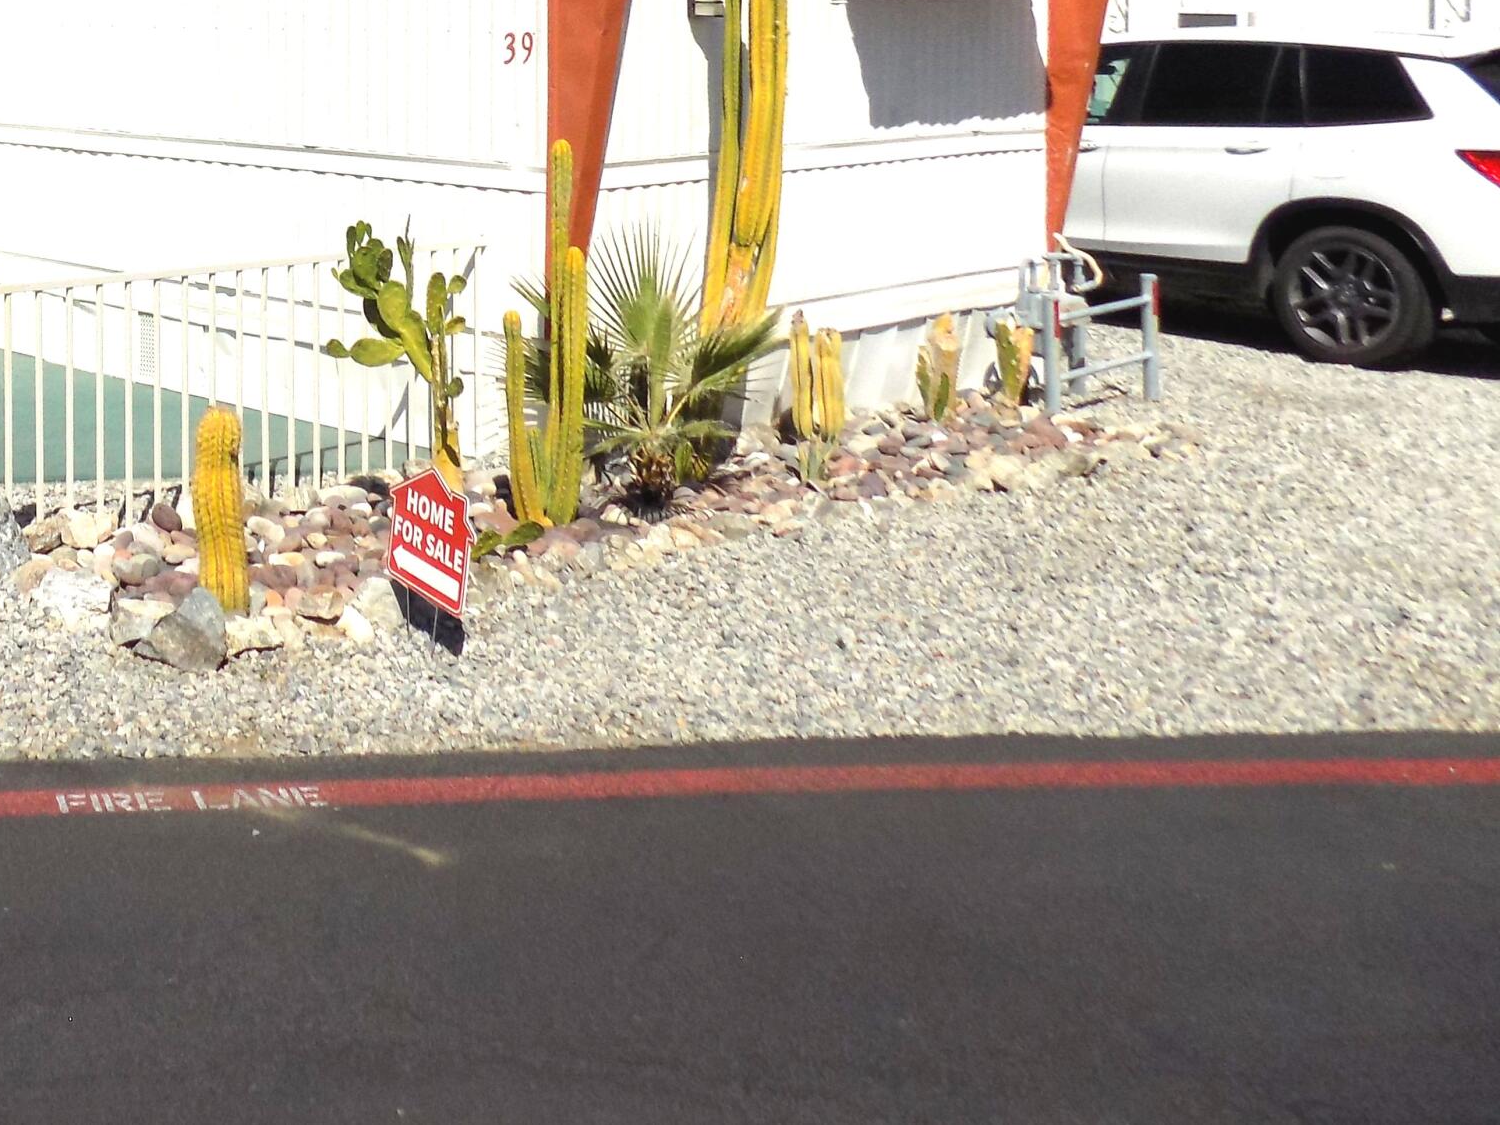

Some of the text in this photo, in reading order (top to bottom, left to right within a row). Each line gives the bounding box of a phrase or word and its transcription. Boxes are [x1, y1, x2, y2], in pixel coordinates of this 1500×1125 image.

[503, 32, 533, 65] 39
[407, 488, 455, 534] HOME
[394, 515, 464, 574] FOR SALE
[56, 789, 172, 813] FIRE
[190, 785, 329, 811] LANE
